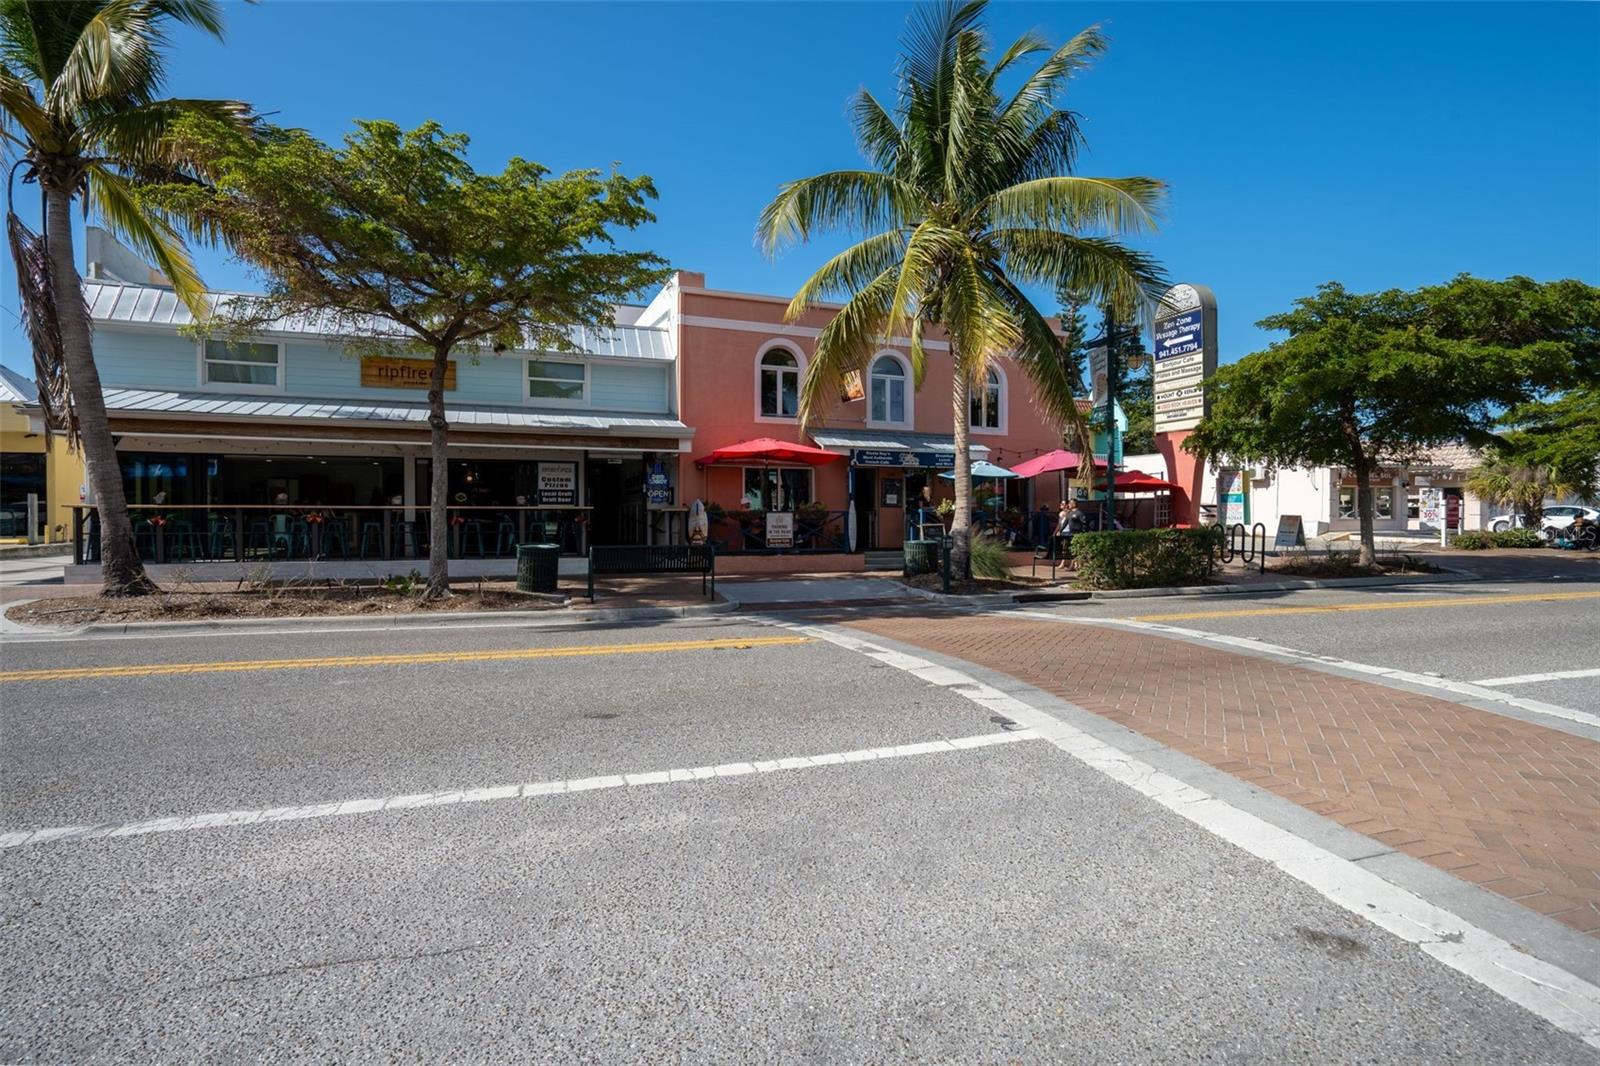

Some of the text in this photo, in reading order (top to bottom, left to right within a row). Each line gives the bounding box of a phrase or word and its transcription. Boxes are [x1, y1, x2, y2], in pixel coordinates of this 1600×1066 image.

[1163, 316, 1192, 330] Zen Zone
[1156, 322, 1201, 340] Massage Therapy
[1158, 342, 1198, 359] 941.451.7794
[1162, 360, 1182, 369] Bonjour
[1171, 369, 1180, 377] and
[1180, 365, 1202, 374] Massage
[378, 365, 427, 381] ripfire
[647, 490, 669, 498] OPEN
